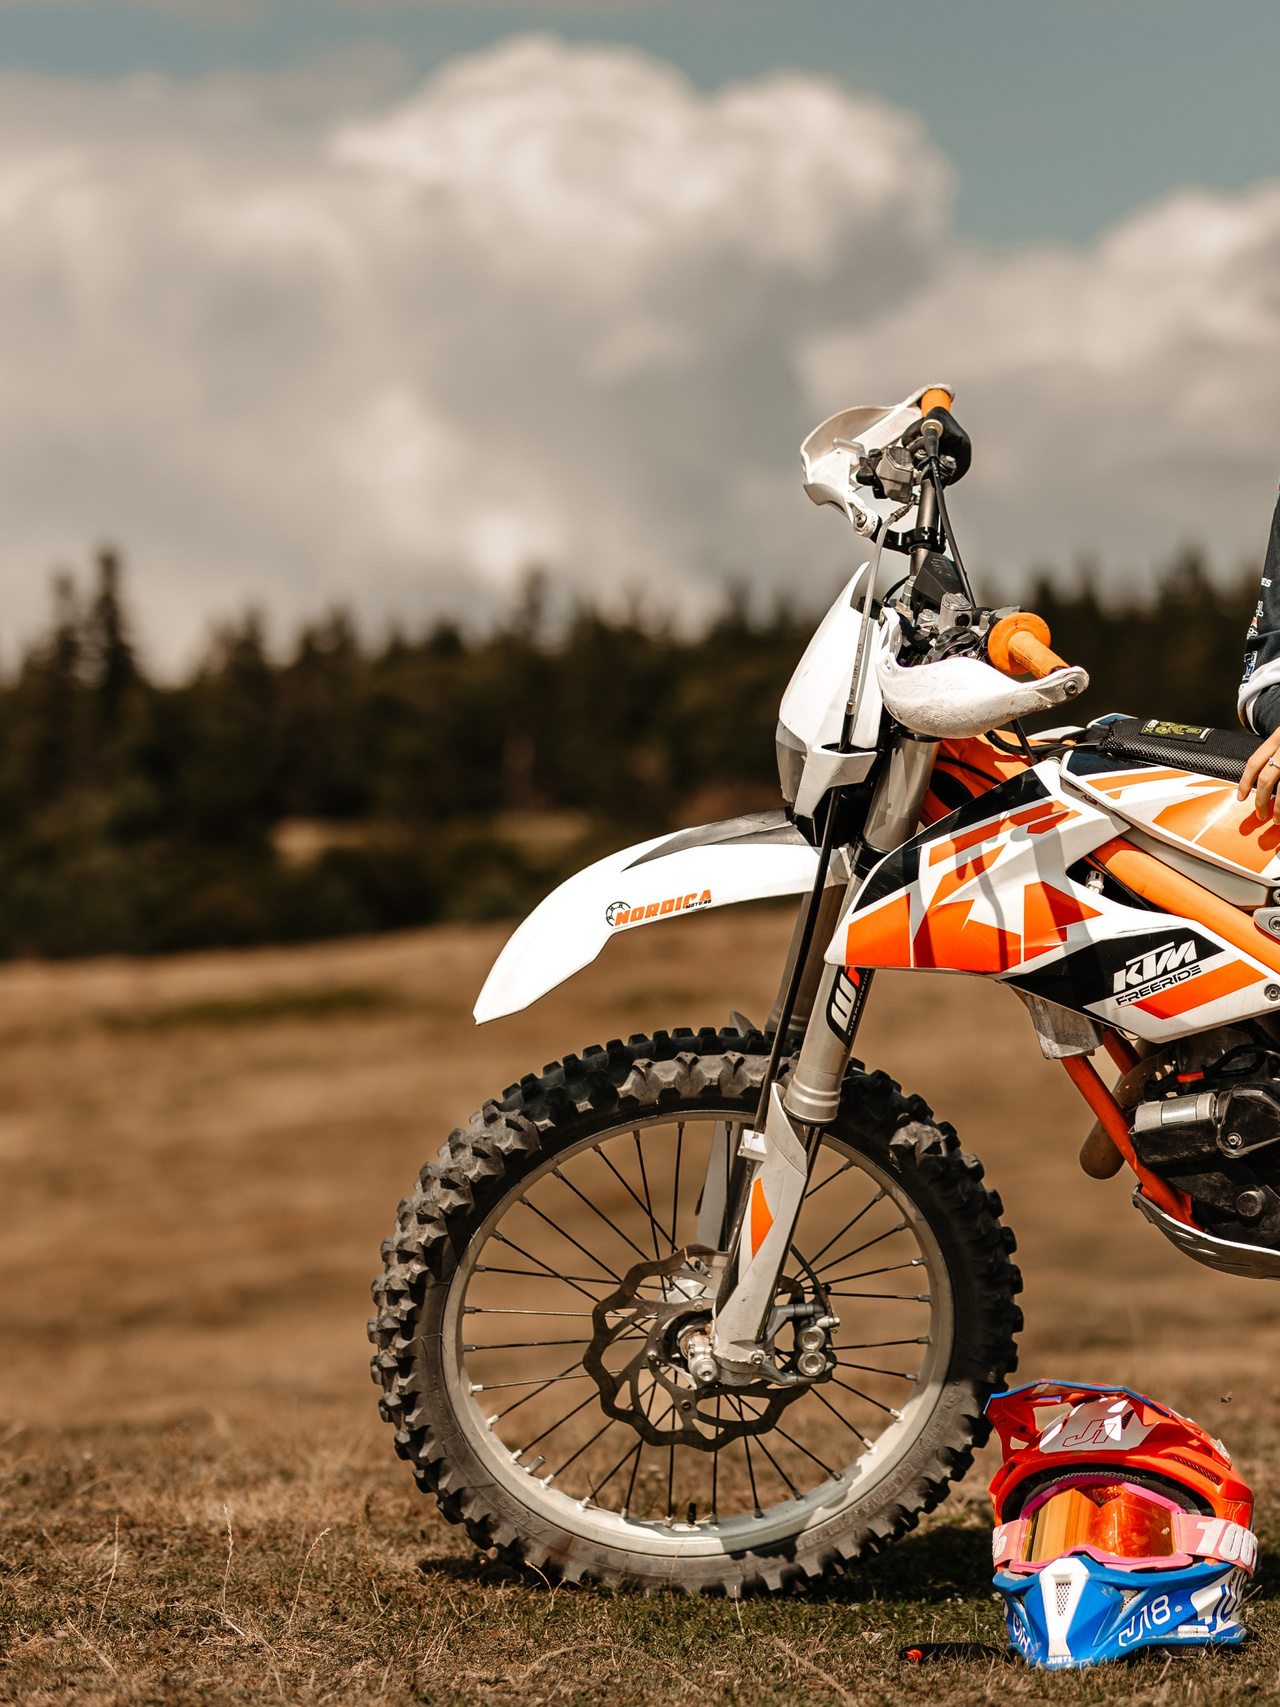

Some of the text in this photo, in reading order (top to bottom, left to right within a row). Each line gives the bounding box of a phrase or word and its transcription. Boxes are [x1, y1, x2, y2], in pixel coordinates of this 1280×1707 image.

[614, 889, 712, 926] NORDICA
[1113, 939, 1198, 994] KTM
[1115, 964, 1202, 1006] FREERIDE
[1196, 1518, 1259, 1572] 100
